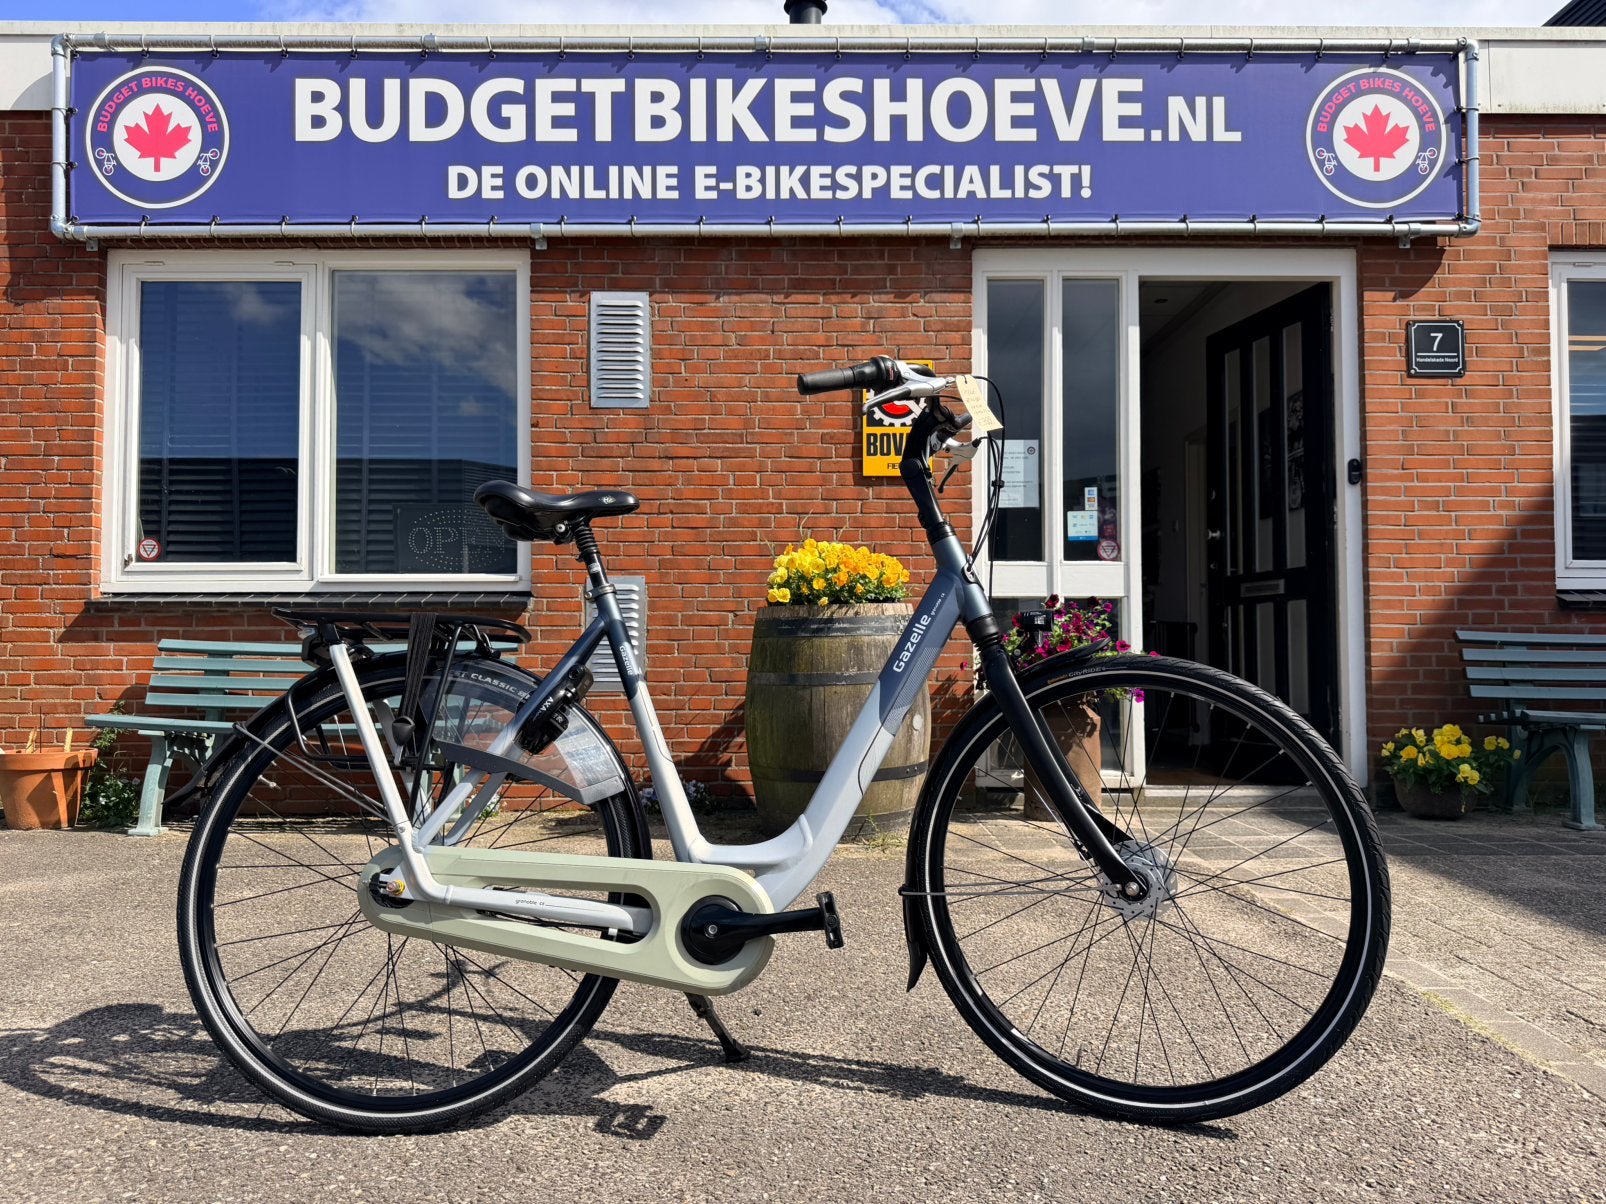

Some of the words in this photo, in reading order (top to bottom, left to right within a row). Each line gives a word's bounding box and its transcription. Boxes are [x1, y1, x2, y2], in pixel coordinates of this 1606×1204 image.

[97, 81, 138, 132] BUDGET
[141, 76, 185, 92] BIKES
[185, 87, 218, 133] HOEVE
[294, 77, 1242, 143] BUDGETBIKESHOEVE.NL
[1316, 82, 1357, 133] BUDGET
[1359, 77, 1402, 93] BIKES
[1402, 87, 1437, 133] HOEVE
[447, 165, 504, 199] DE
[515, 164, 680, 200] ONLINE
[694, 164, 1093, 200] E-BIKESPECIALIST!
[1430, 333, 1443, 351] 7
[892, 614, 932, 673] Gazelle
[470, 672, 518, 694] CLASSIC
